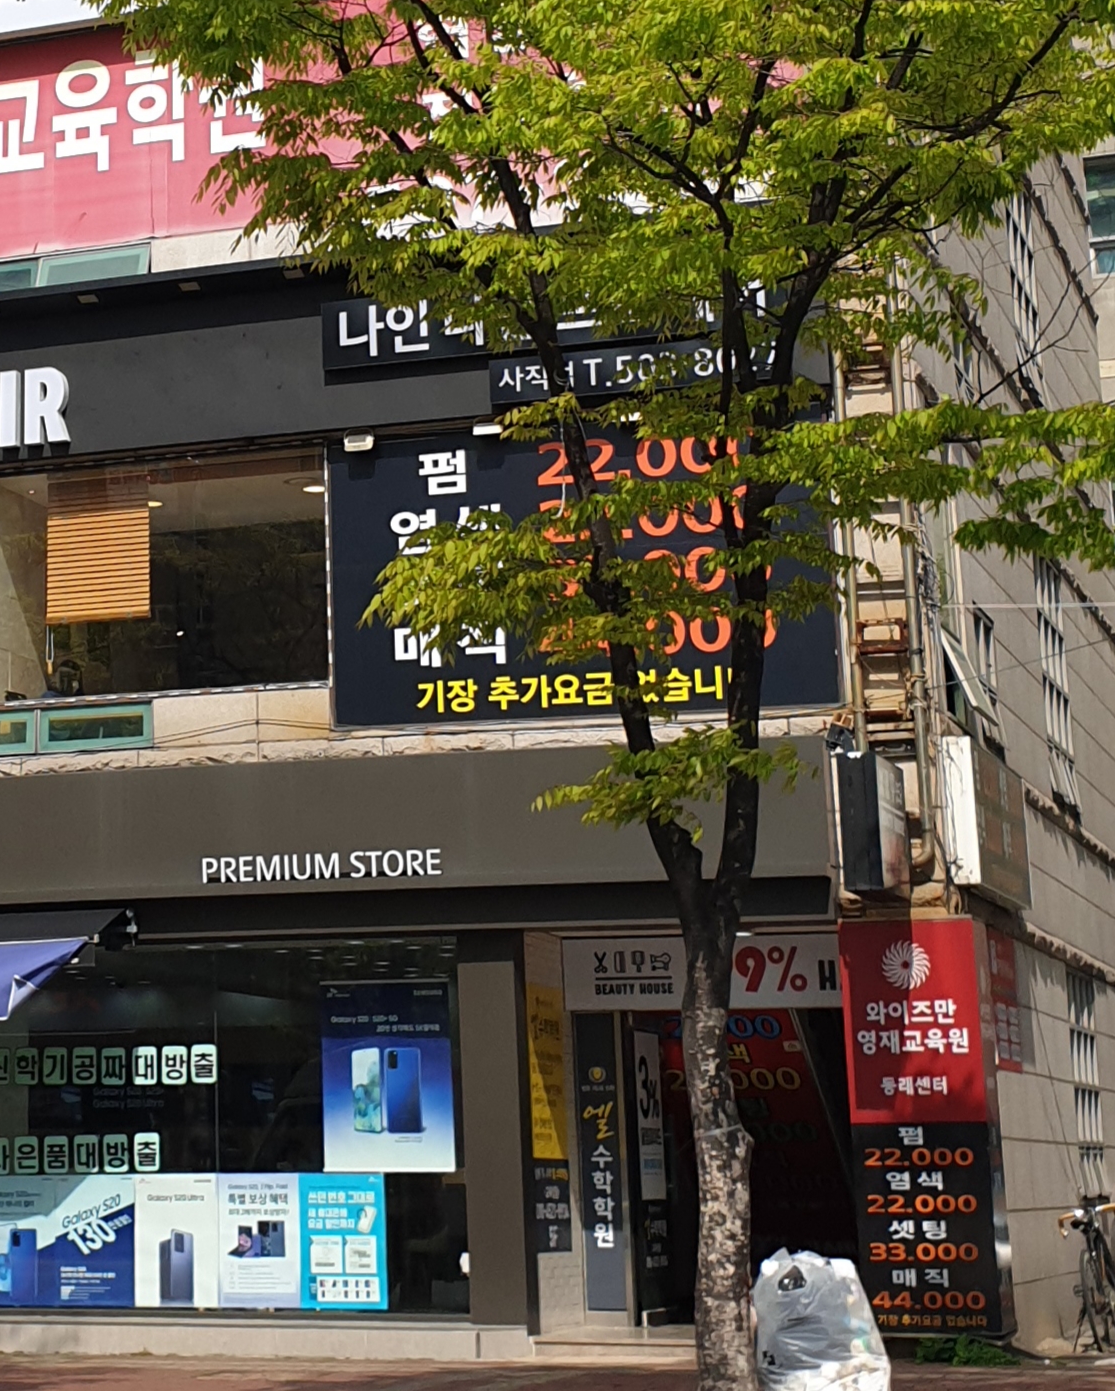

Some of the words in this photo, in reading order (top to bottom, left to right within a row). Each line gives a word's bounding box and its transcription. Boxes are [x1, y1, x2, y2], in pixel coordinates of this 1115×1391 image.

[418, 449, 467, 496] 펌
[417, 678, 478, 713] 기장
[488, 671, 614, 711] 추가요금
[201, 852, 341, 884] PREMIUM
[349, 848, 443, 878] STORE
[595, 983, 636, 996] BEAUTY
[639, 981, 674, 995] HOUSE
[866, 998, 957, 1027] 와이즈만
[857, 1027, 970, 1056] 영재교육원
[880, 1075, 948, 1098] 동래센터
[899, 1126, 925, 1146] 펌
[864, 1147, 974, 1167] 22.000
[62, 1203, 101, 1229] Galaxy
[102, 1193, 122, 1212] S20
[590, 1144, 615, 1249] 수학학원
[867, 1194, 977, 1214] 22.000
[66, 1218, 117, 1256] 130
[869, 1242, 979, 1263] 33.000
[872, 1290, 986, 1310] 44.000
